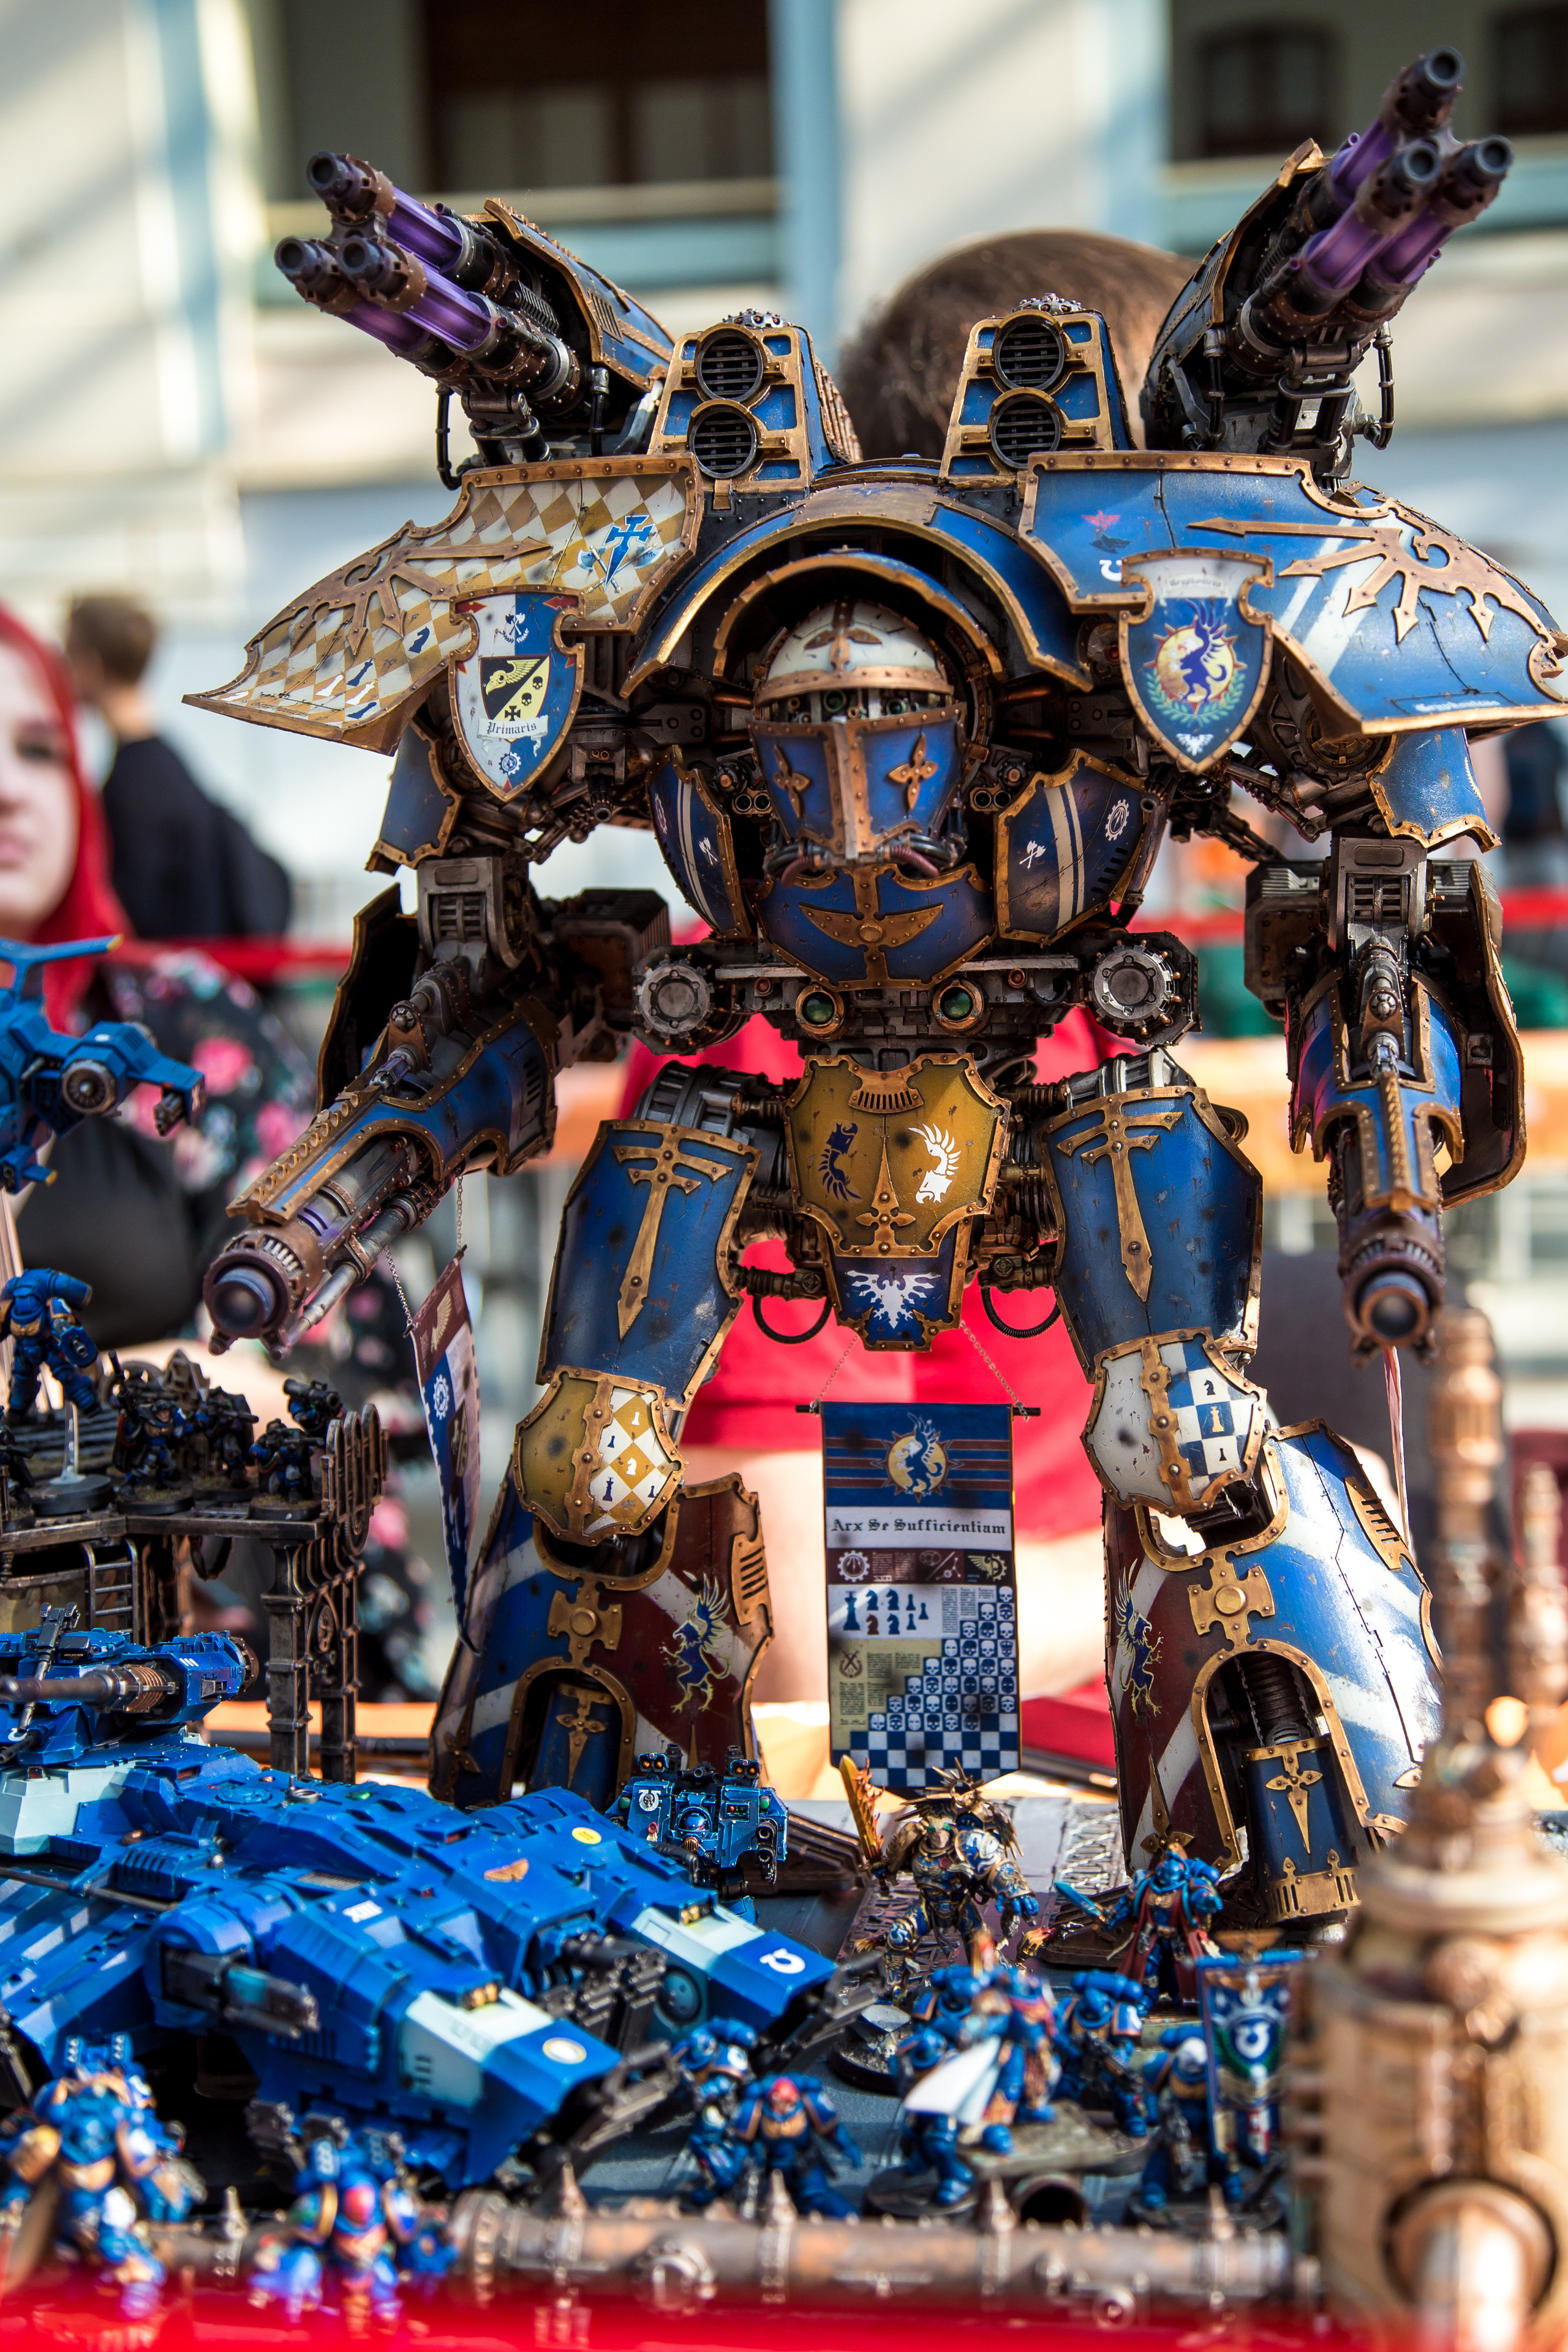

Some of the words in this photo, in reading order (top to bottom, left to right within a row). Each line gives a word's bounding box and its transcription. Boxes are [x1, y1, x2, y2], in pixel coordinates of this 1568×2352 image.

[487, 722, 537, 734] Primaris
[831, 1519, 863, 1532] Arx
[868, 1519, 889, 1531] Se
[894, 1519, 1006, 1534] Sufficientiam
